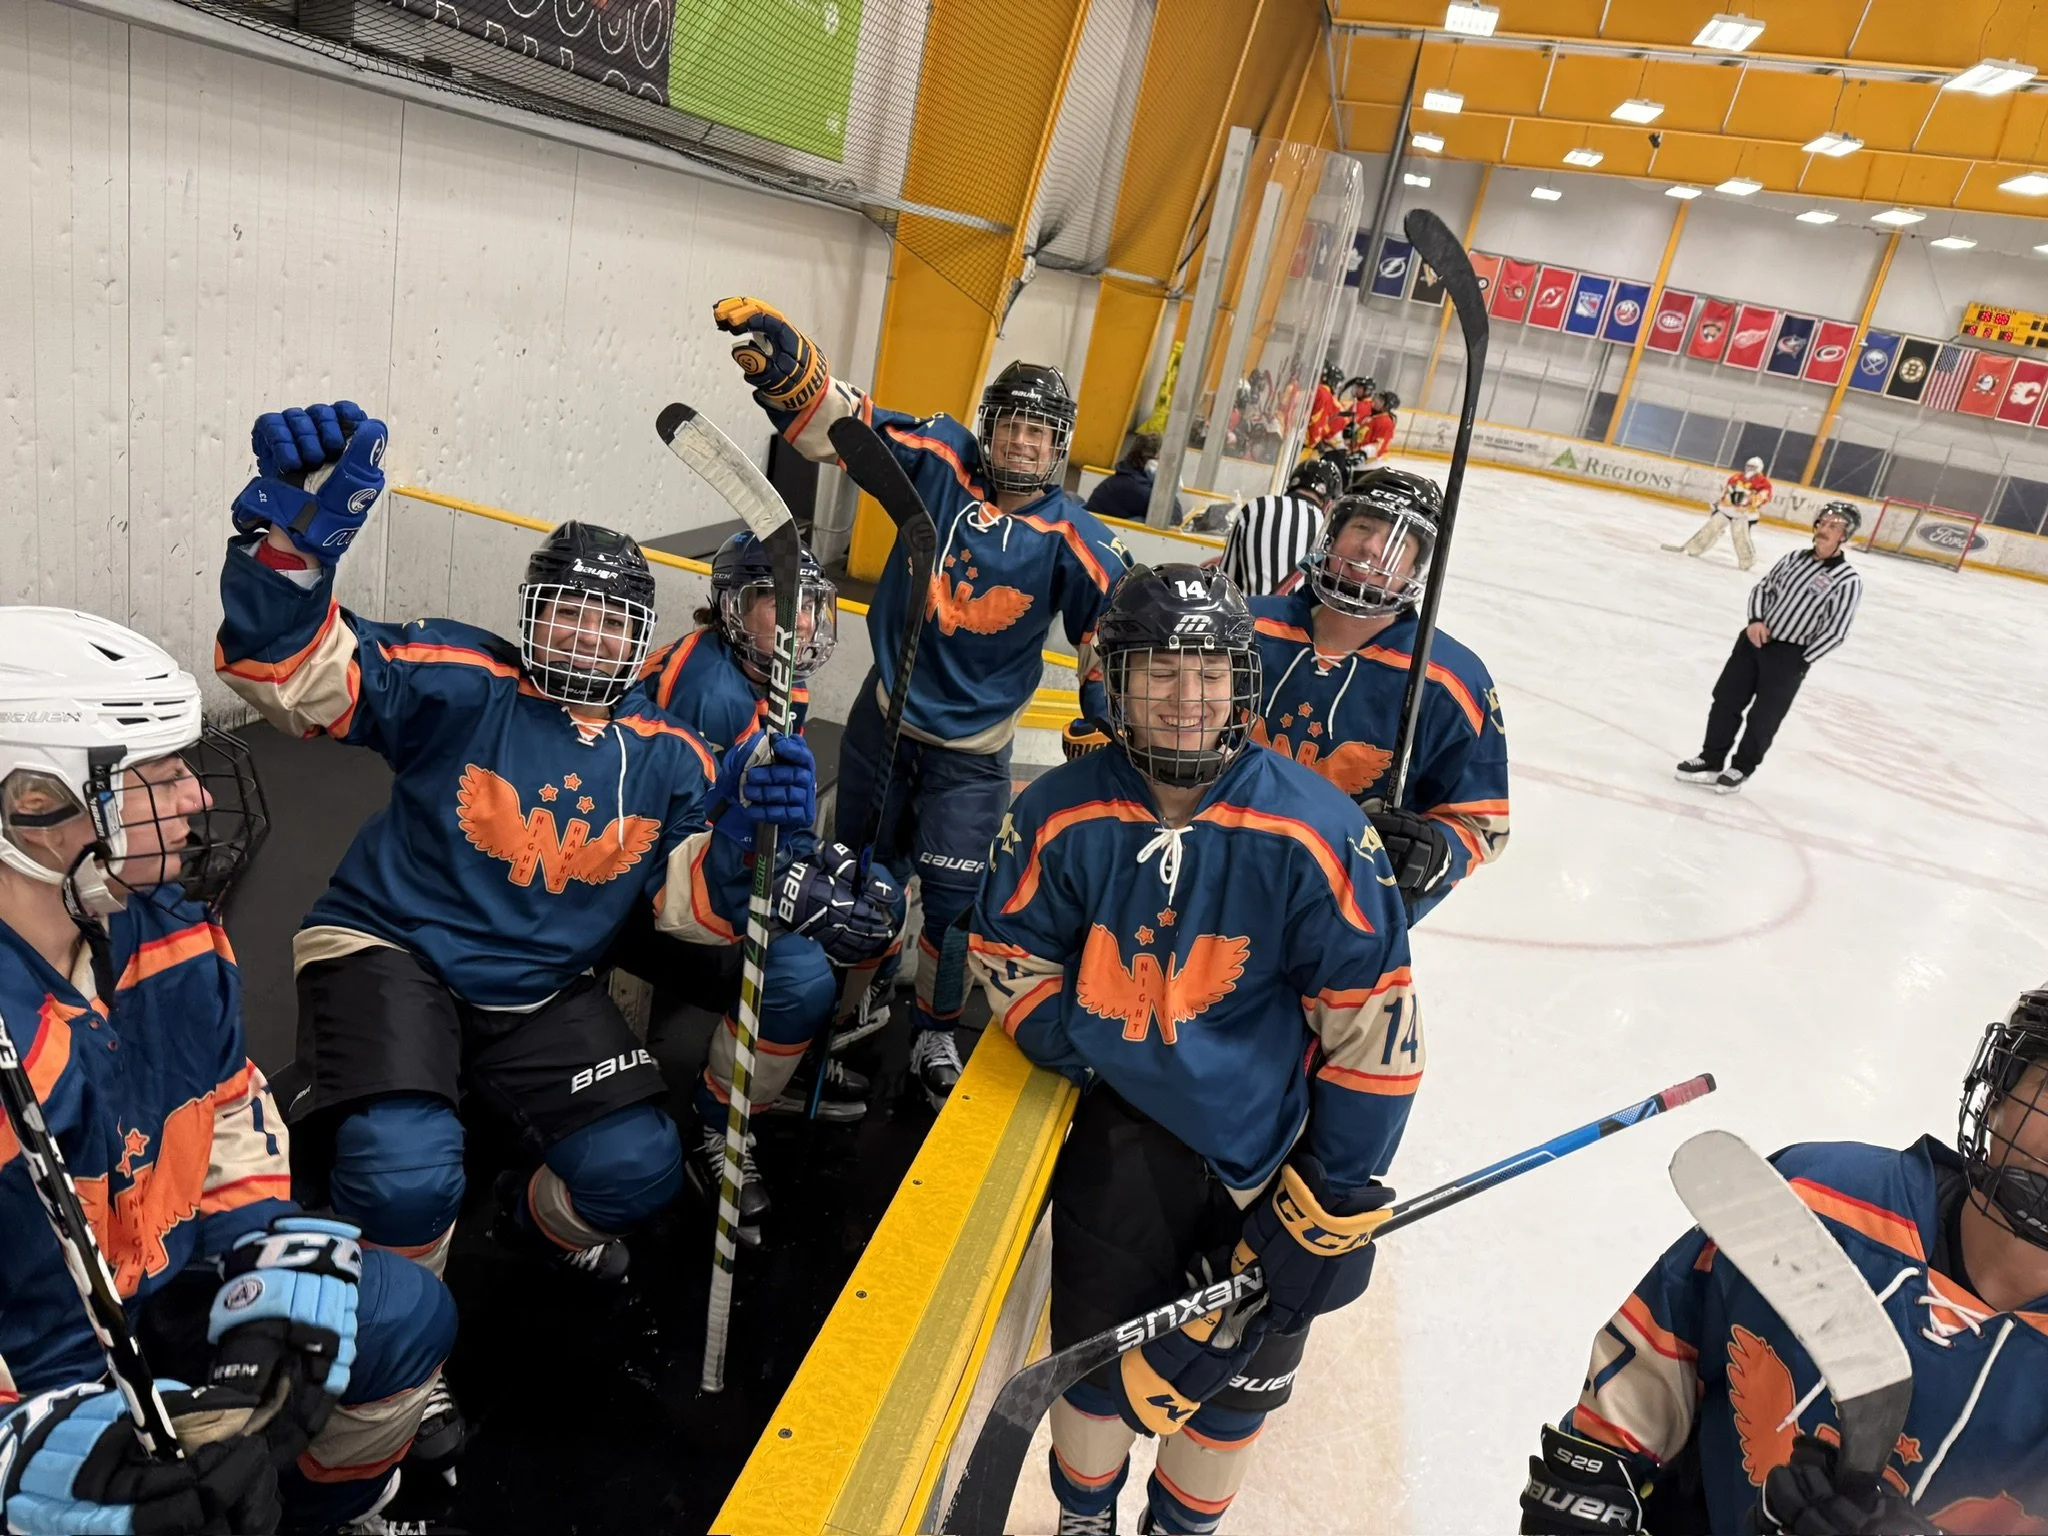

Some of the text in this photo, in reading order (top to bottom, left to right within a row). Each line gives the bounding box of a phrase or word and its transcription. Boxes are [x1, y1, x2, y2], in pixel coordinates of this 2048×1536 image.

[1370, 488, 1412, 506] CCM
[1583, 457, 1675, 490] REGIONS
[800, 568, 818, 576] CM
[1175, 580, 1207, 599] 14
[767, 624, 793, 736] UER
[518, 815, 544, 878] NIGHT
[554, 826, 581, 886] HAWKS
[778, 862, 808, 923] BAU
[1133, 962, 1149, 1033] NIGHT
[1381, 993, 1418, 1065] 14
[1115, 1266, 1263, 1353] NEXUS
[1553, 1447, 1603, 1474] S29
[1525, 1479, 1632, 1529] AUER
